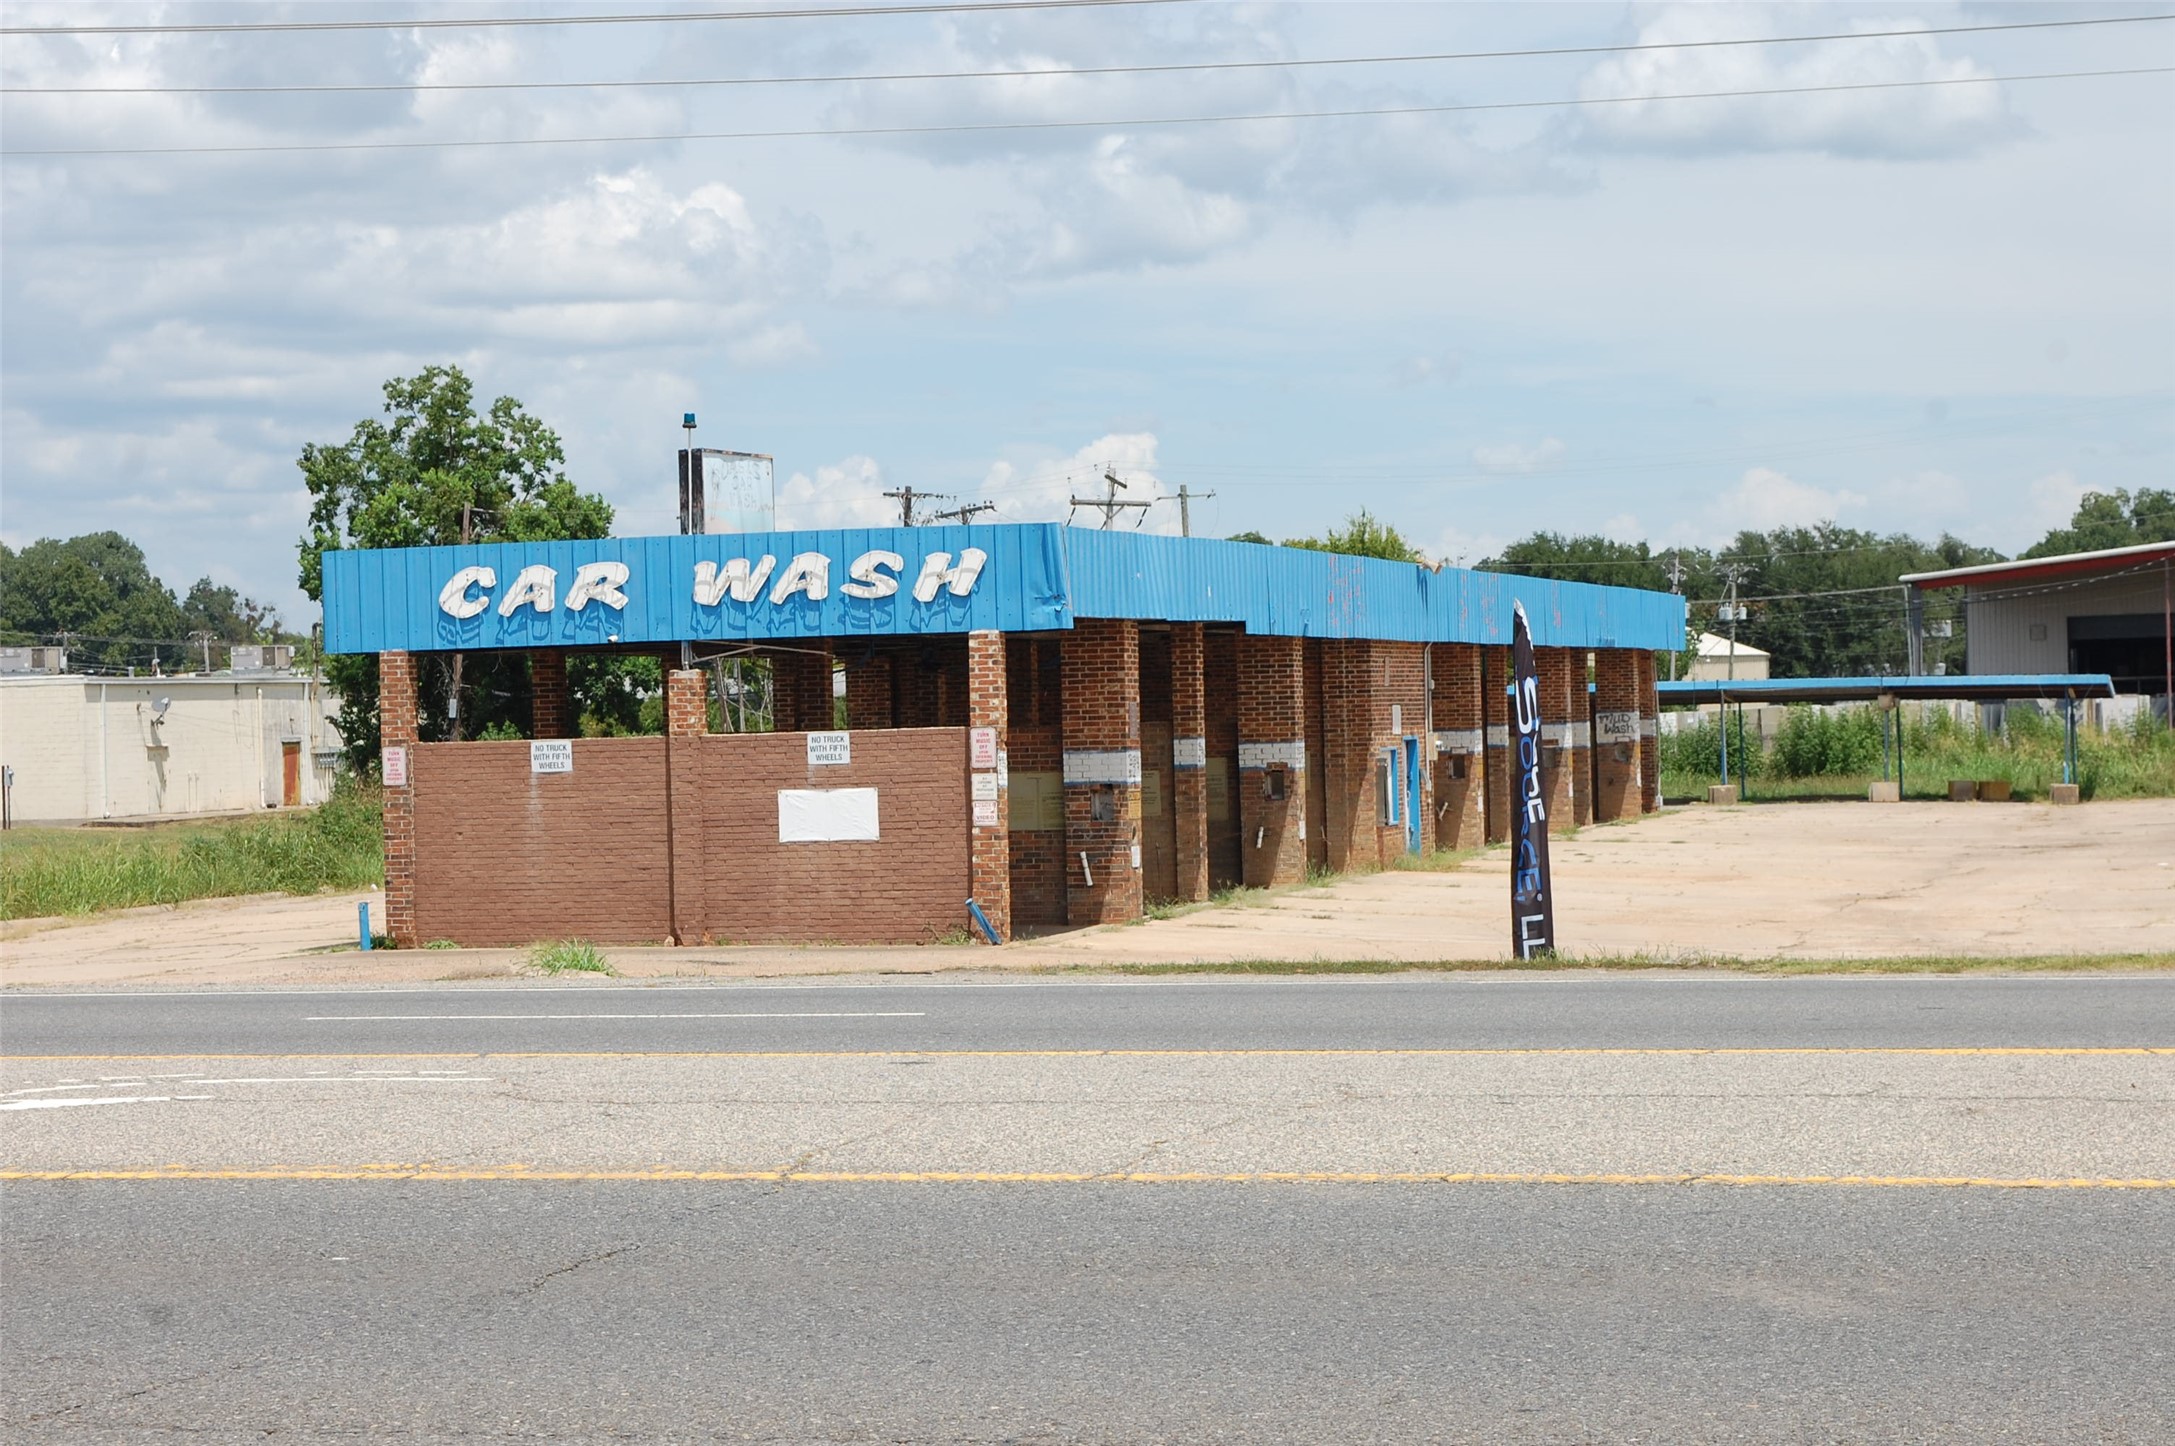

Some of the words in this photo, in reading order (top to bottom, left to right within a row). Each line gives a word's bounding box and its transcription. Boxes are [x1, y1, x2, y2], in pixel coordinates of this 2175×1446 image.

[438, 562, 630, 619] CAR
[693, 547, 988, 606] WASH
[811, 736, 821, 744] NO
[823, 735, 845, 743] TRUCK
[535, 744, 544, 752] NO
[829, 744, 848, 752] FIFTH
[533, 753, 550, 761] WITH
[552, 752, 571, 760] FIFTH
[815, 753, 843, 761] WHEELS
[539, 761, 566, 769] WHEELS
